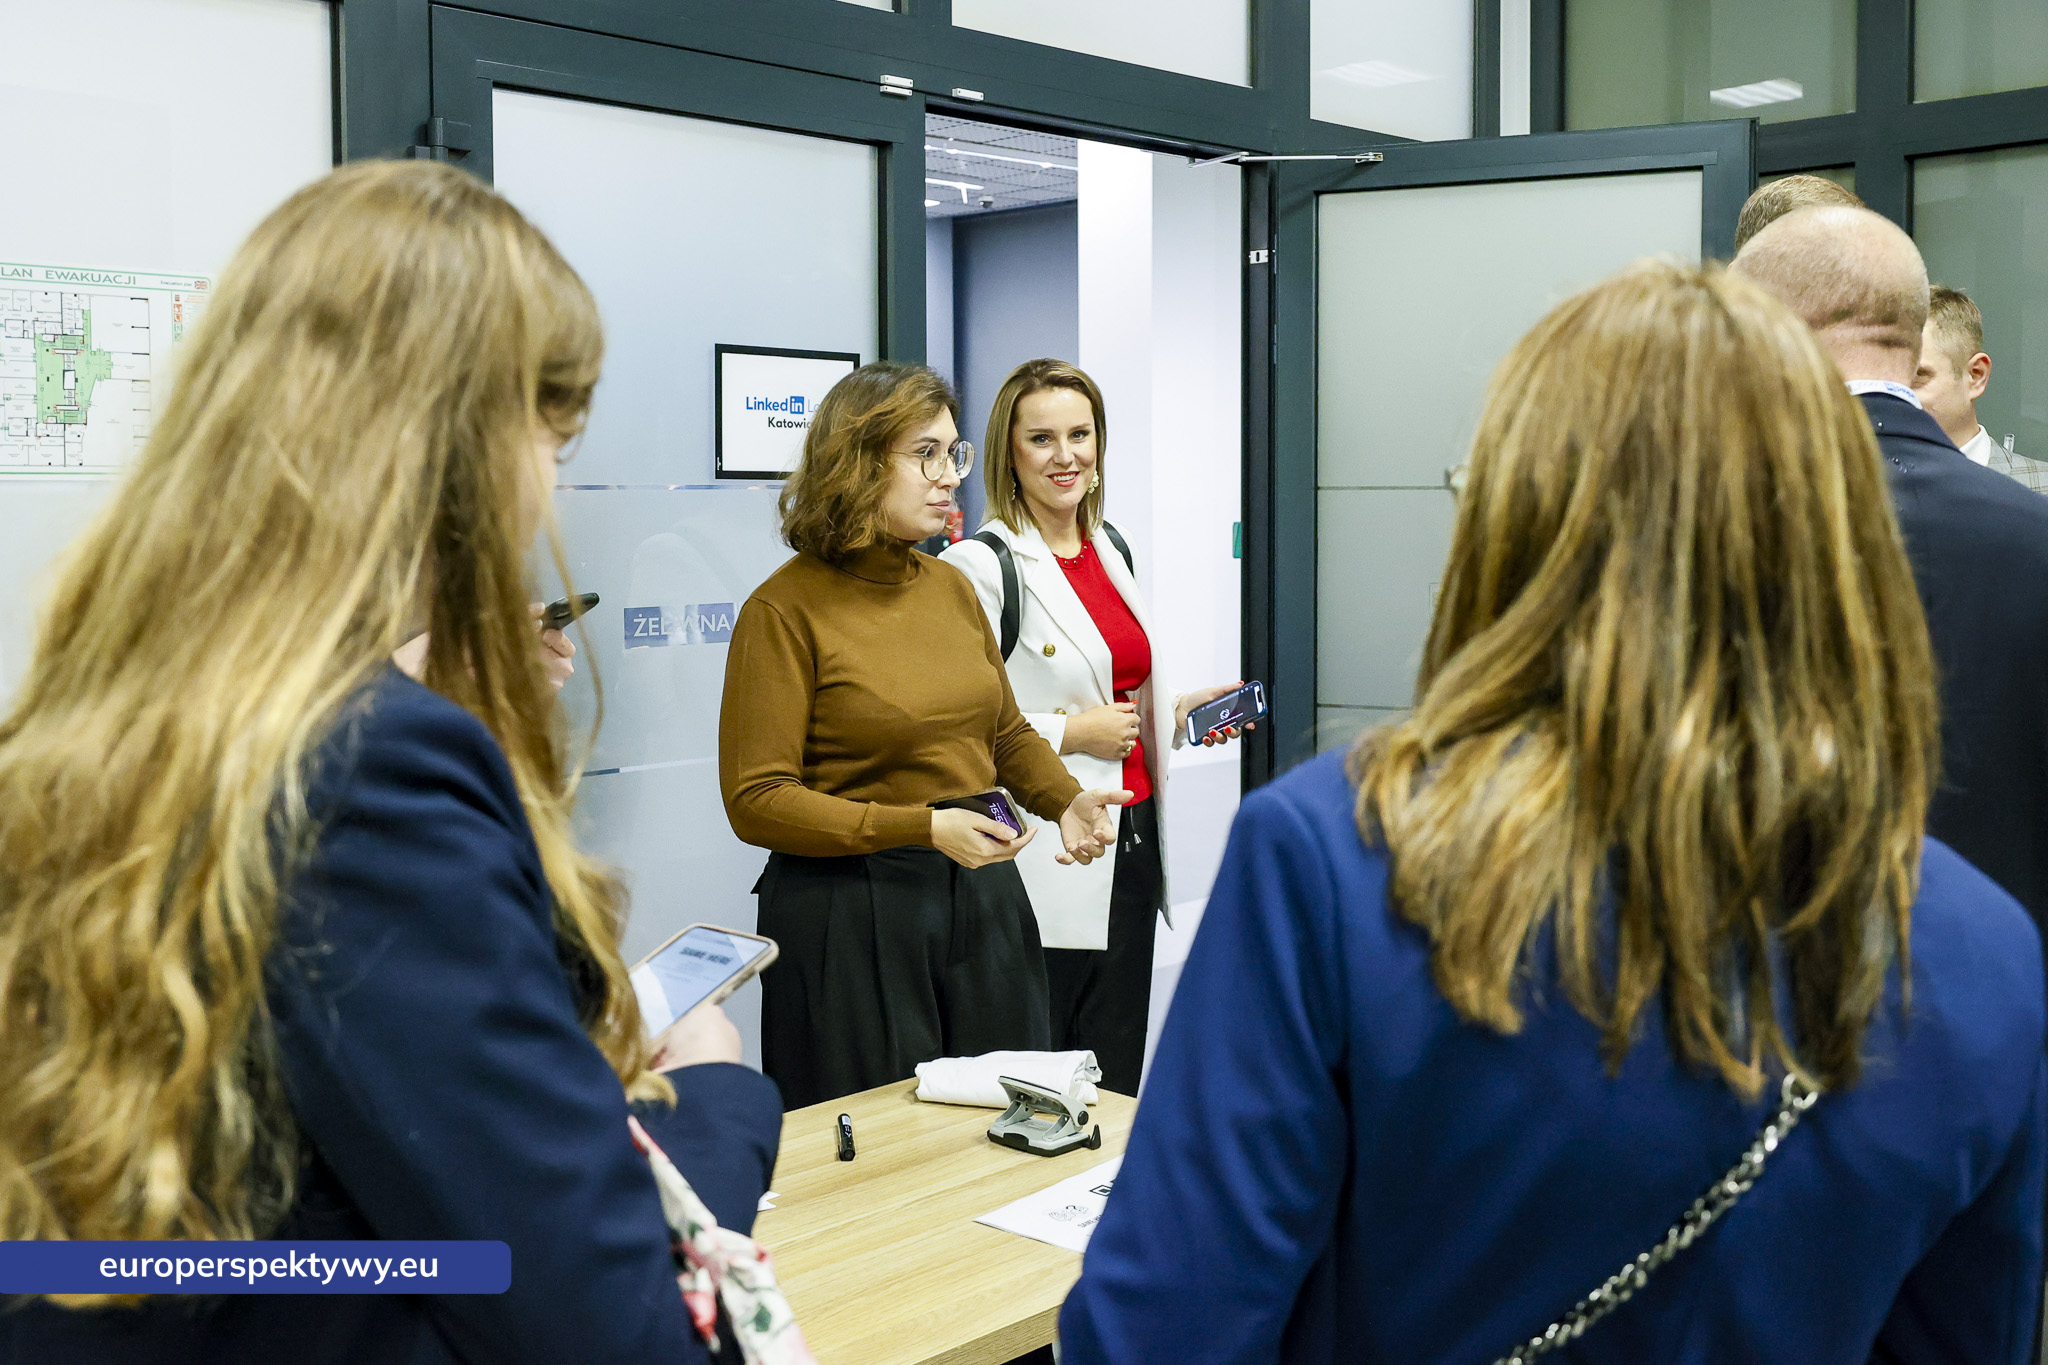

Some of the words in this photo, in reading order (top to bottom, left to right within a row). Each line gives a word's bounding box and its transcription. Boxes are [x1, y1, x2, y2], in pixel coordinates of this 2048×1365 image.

[1, 266, 33, 278] LAN
[45, 270, 136, 285] EWAKUACJI
[989, 802, 1006, 824] 15:5
